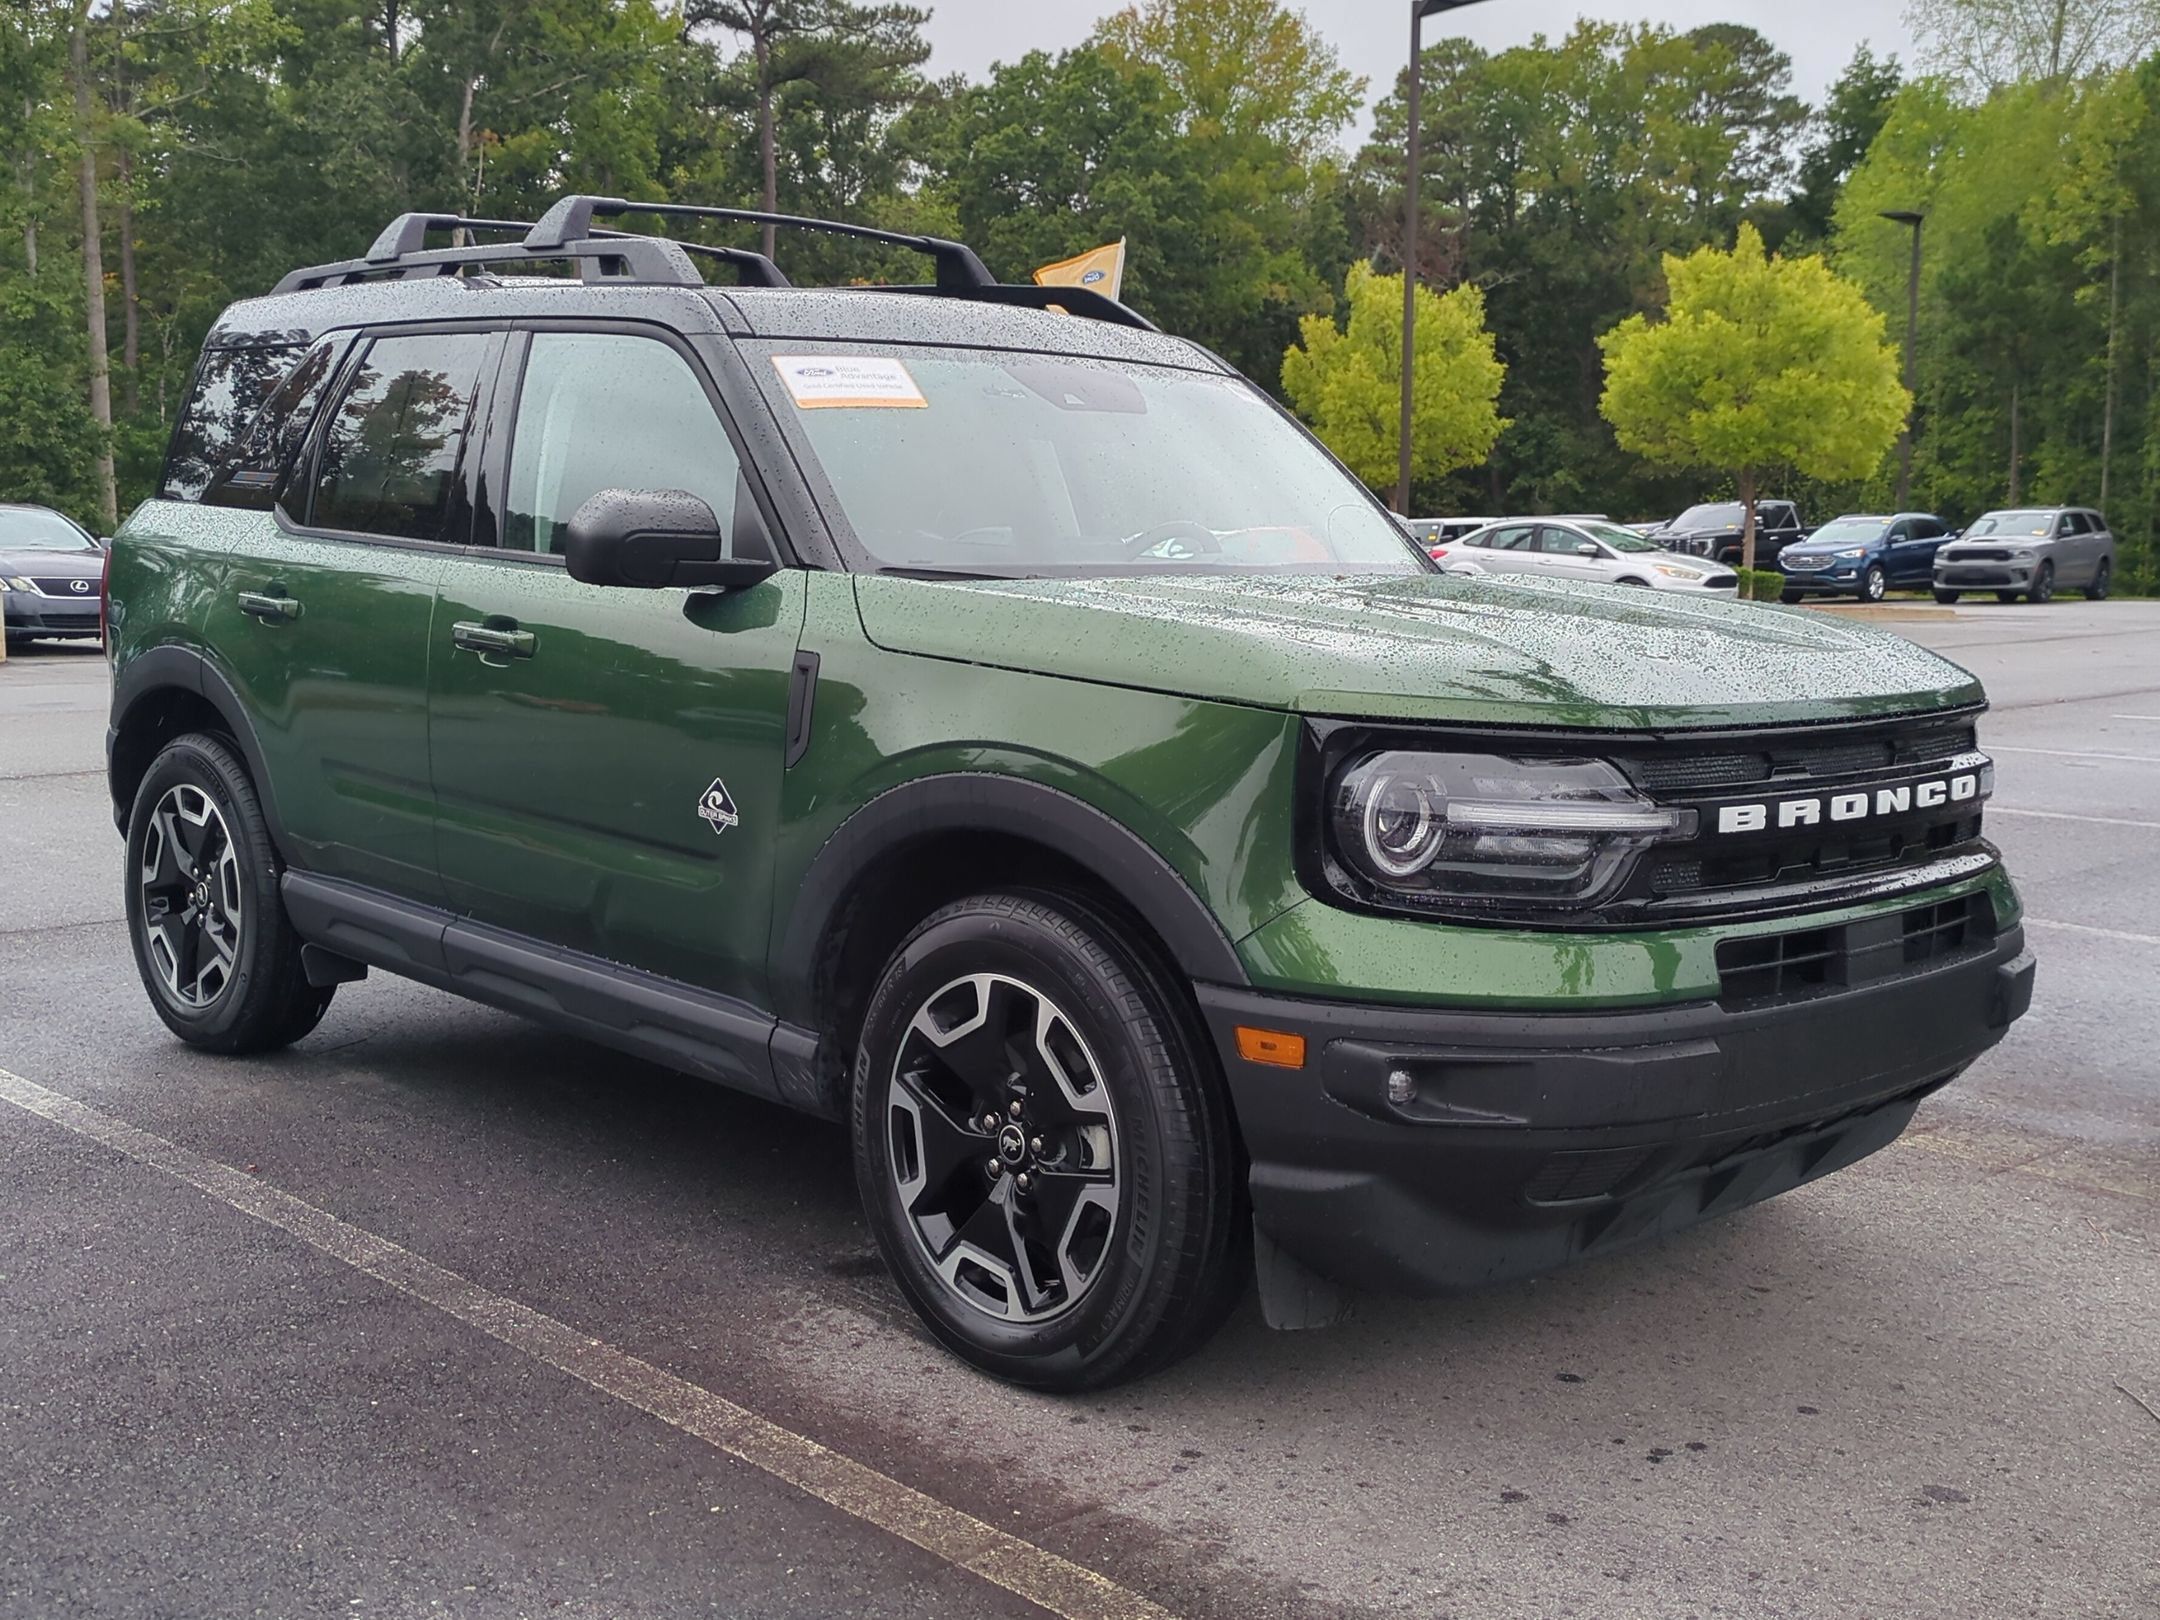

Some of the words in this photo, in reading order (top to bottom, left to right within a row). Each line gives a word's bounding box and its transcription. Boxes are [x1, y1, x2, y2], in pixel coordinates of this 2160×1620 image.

[835, 365, 860, 373] Blue
[840, 371, 897, 382] Advantage
[1717, 774, 1978, 834] BRONCO
[1130, 1116, 1151, 1261] MICHELIN
